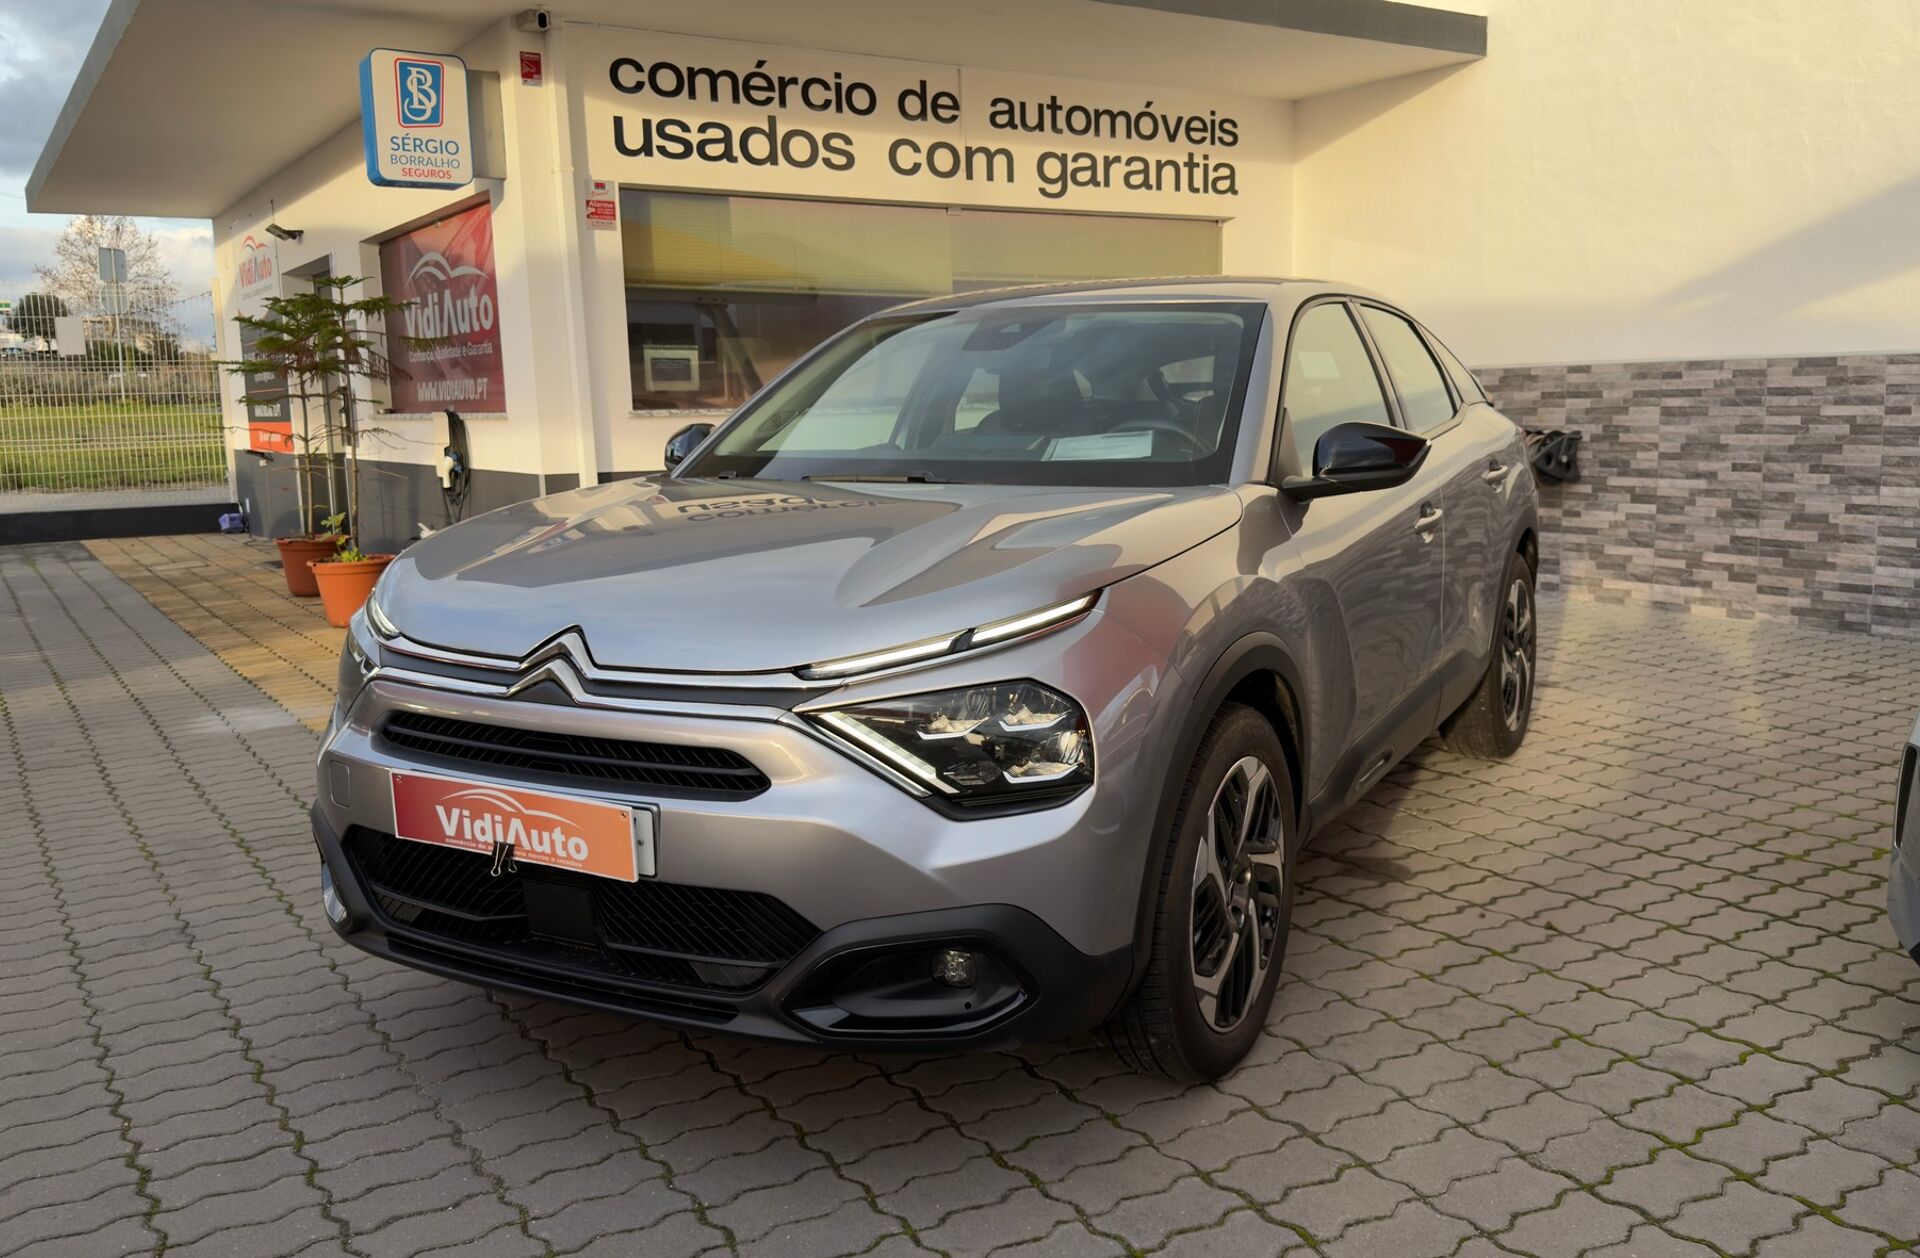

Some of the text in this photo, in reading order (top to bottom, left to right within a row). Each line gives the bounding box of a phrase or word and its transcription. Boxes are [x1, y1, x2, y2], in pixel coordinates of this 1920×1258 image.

[608, 56, 1239, 147] comércio de automóveis
[390, 132, 460, 156] SÉRGIO
[612, 114, 1239, 199] usados com garantia
[390, 154, 461, 169] BORRALHO
[402, 167, 452, 180] SEGUROS
[239, 255, 272, 288] VidiAuto
[403, 285, 494, 339] VidiAuto
[417, 377, 489, 402] WWW.VIDIAUTO.PT
[435, 804, 589, 861] VidiAuto
